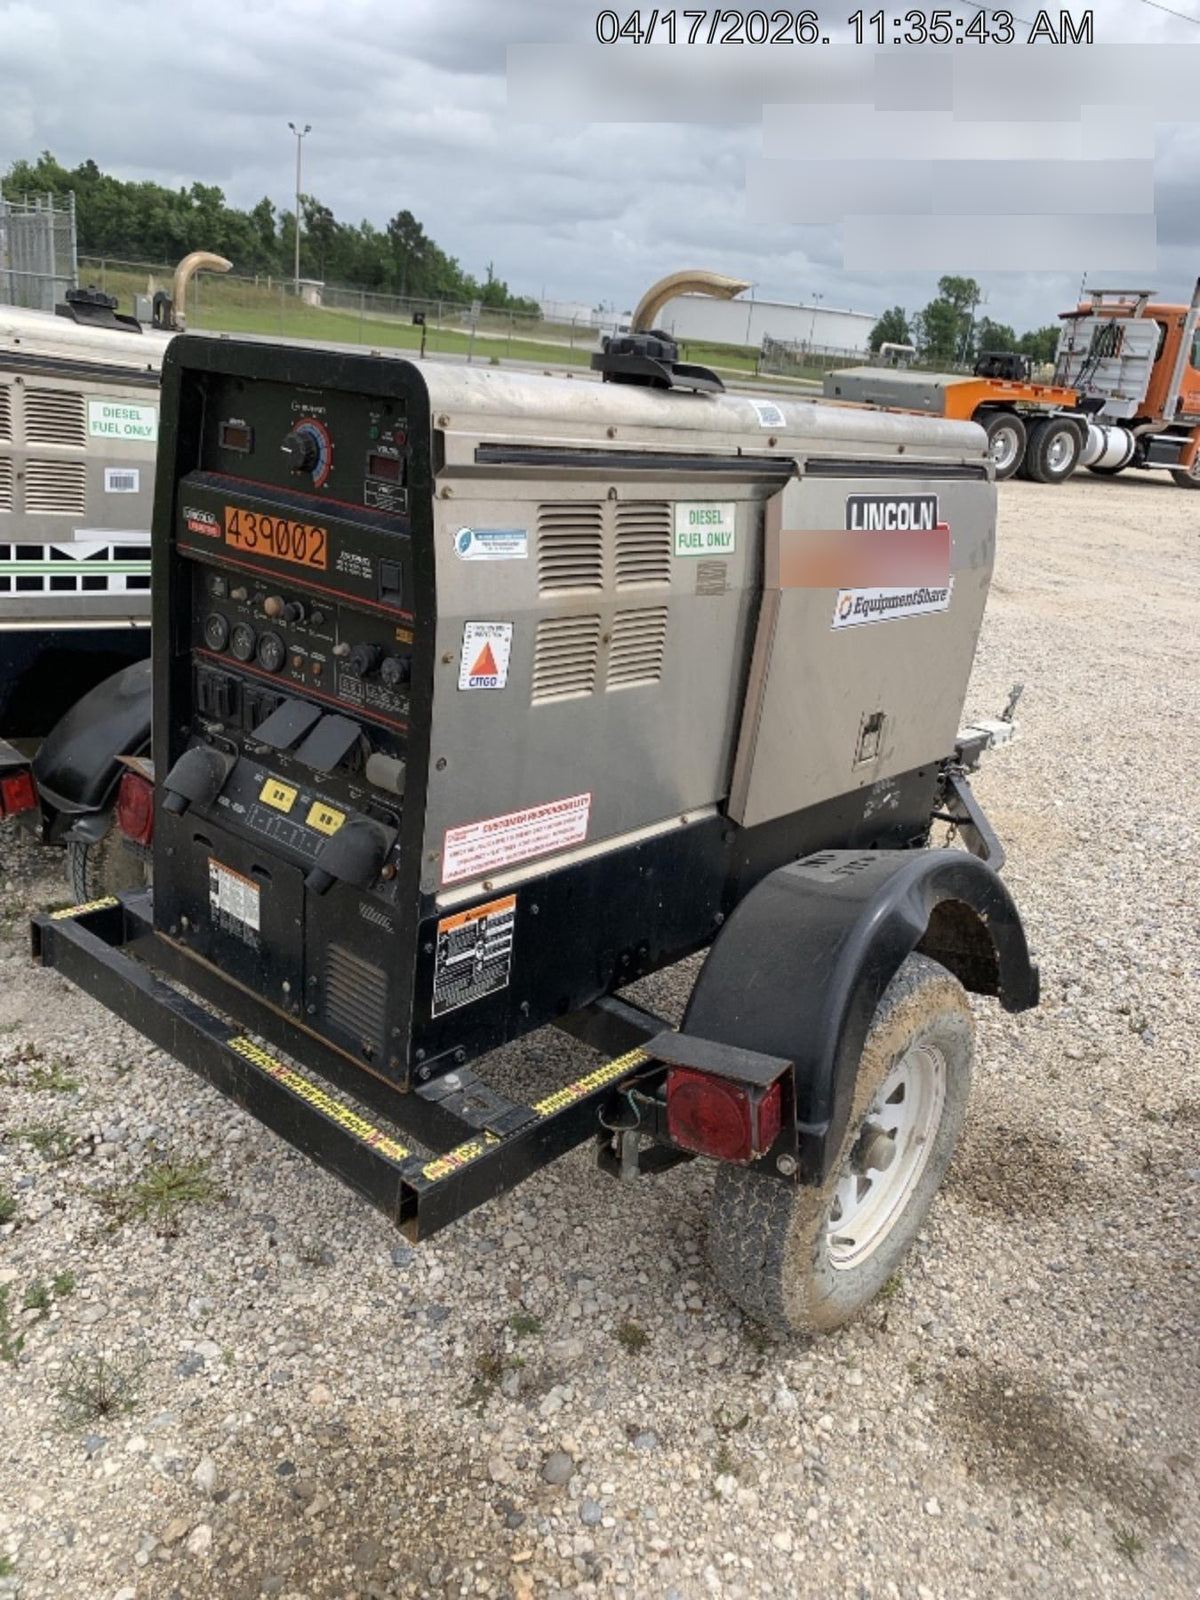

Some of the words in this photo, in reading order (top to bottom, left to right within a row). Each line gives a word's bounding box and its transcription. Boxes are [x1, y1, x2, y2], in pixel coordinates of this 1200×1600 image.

[102, 407, 142, 420] DIESEL
[92, 421, 121, 434] FUEL
[123, 424, 152, 436] ONLY
[689, 509, 724, 525] DIESEL
[851, 501, 934, 531] LINCOLN
[227, 509, 325, 566] 439002
[678, 533, 704, 548] FUEL
[706, 531, 732, 547] ONLY
[853, 588, 948, 617] EquipmentShare
[468, 676, 497, 688] CITGO
